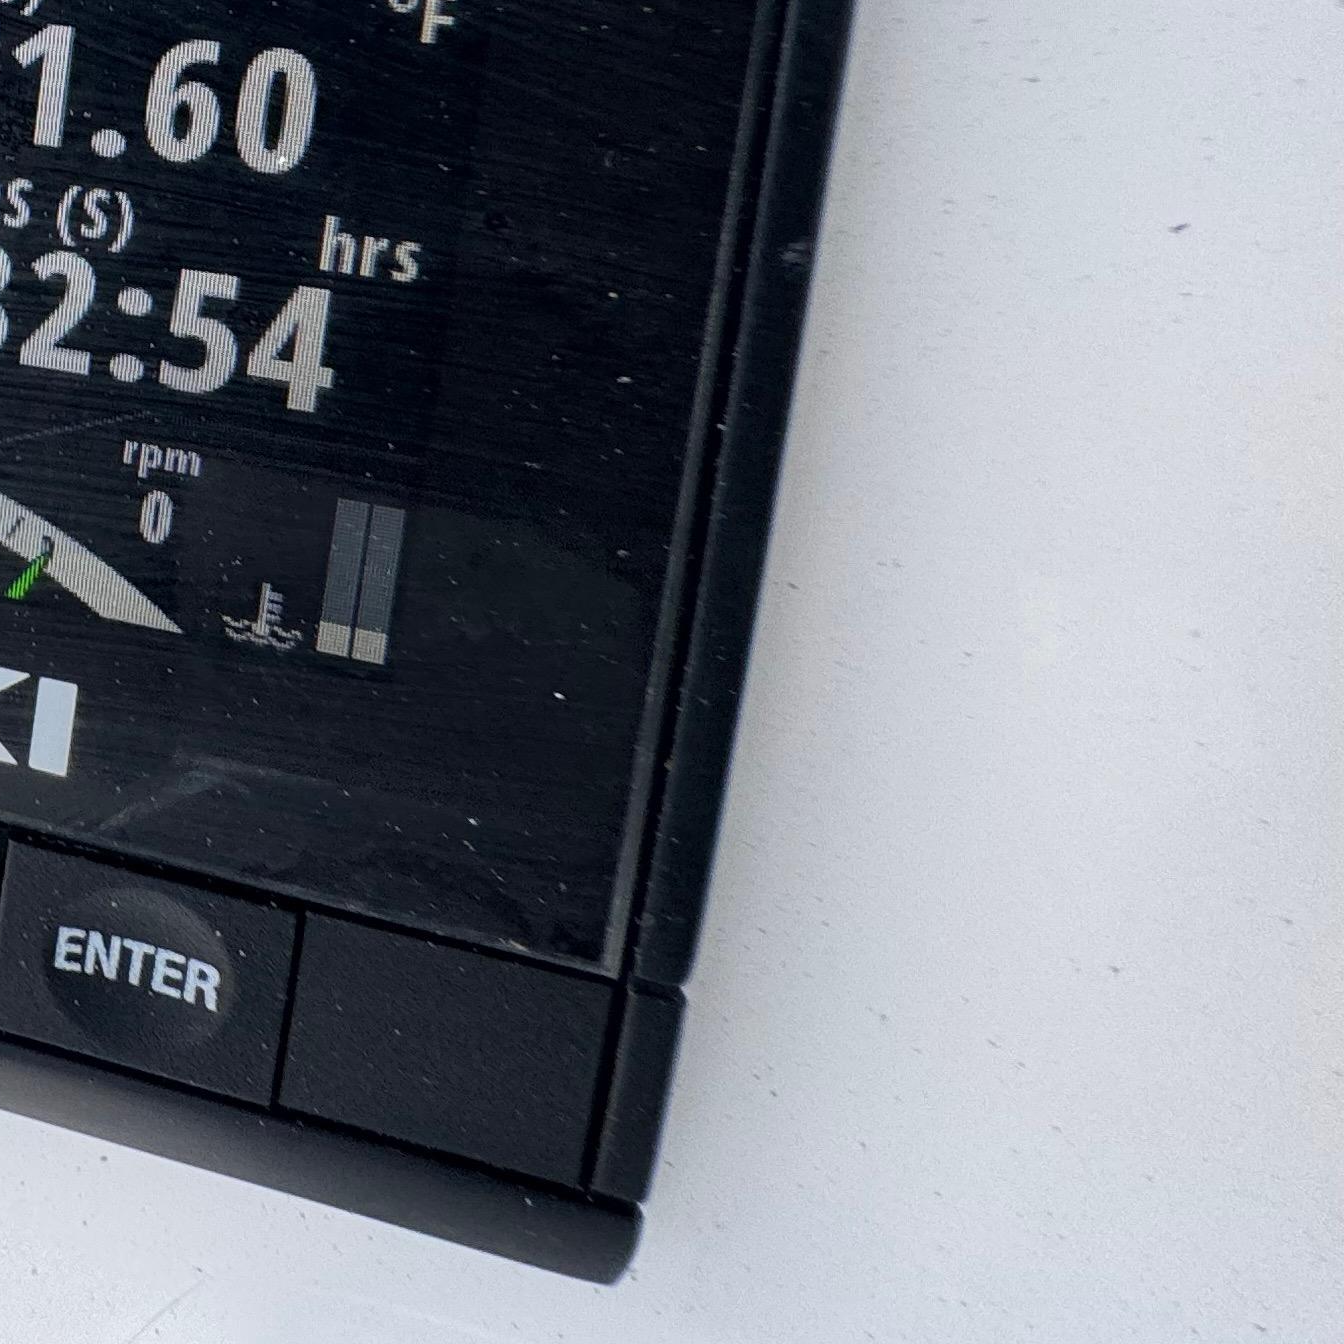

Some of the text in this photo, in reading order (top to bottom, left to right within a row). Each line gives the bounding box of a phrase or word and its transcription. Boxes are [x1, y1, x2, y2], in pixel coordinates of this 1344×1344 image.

[57, 184, 135, 255] (S)
[318, 214, 423, 285] hrs
[121, 436, 202, 483] rpm
[138, 488, 176, 546] 0
[52, 924, 222, 1014] ENTER
